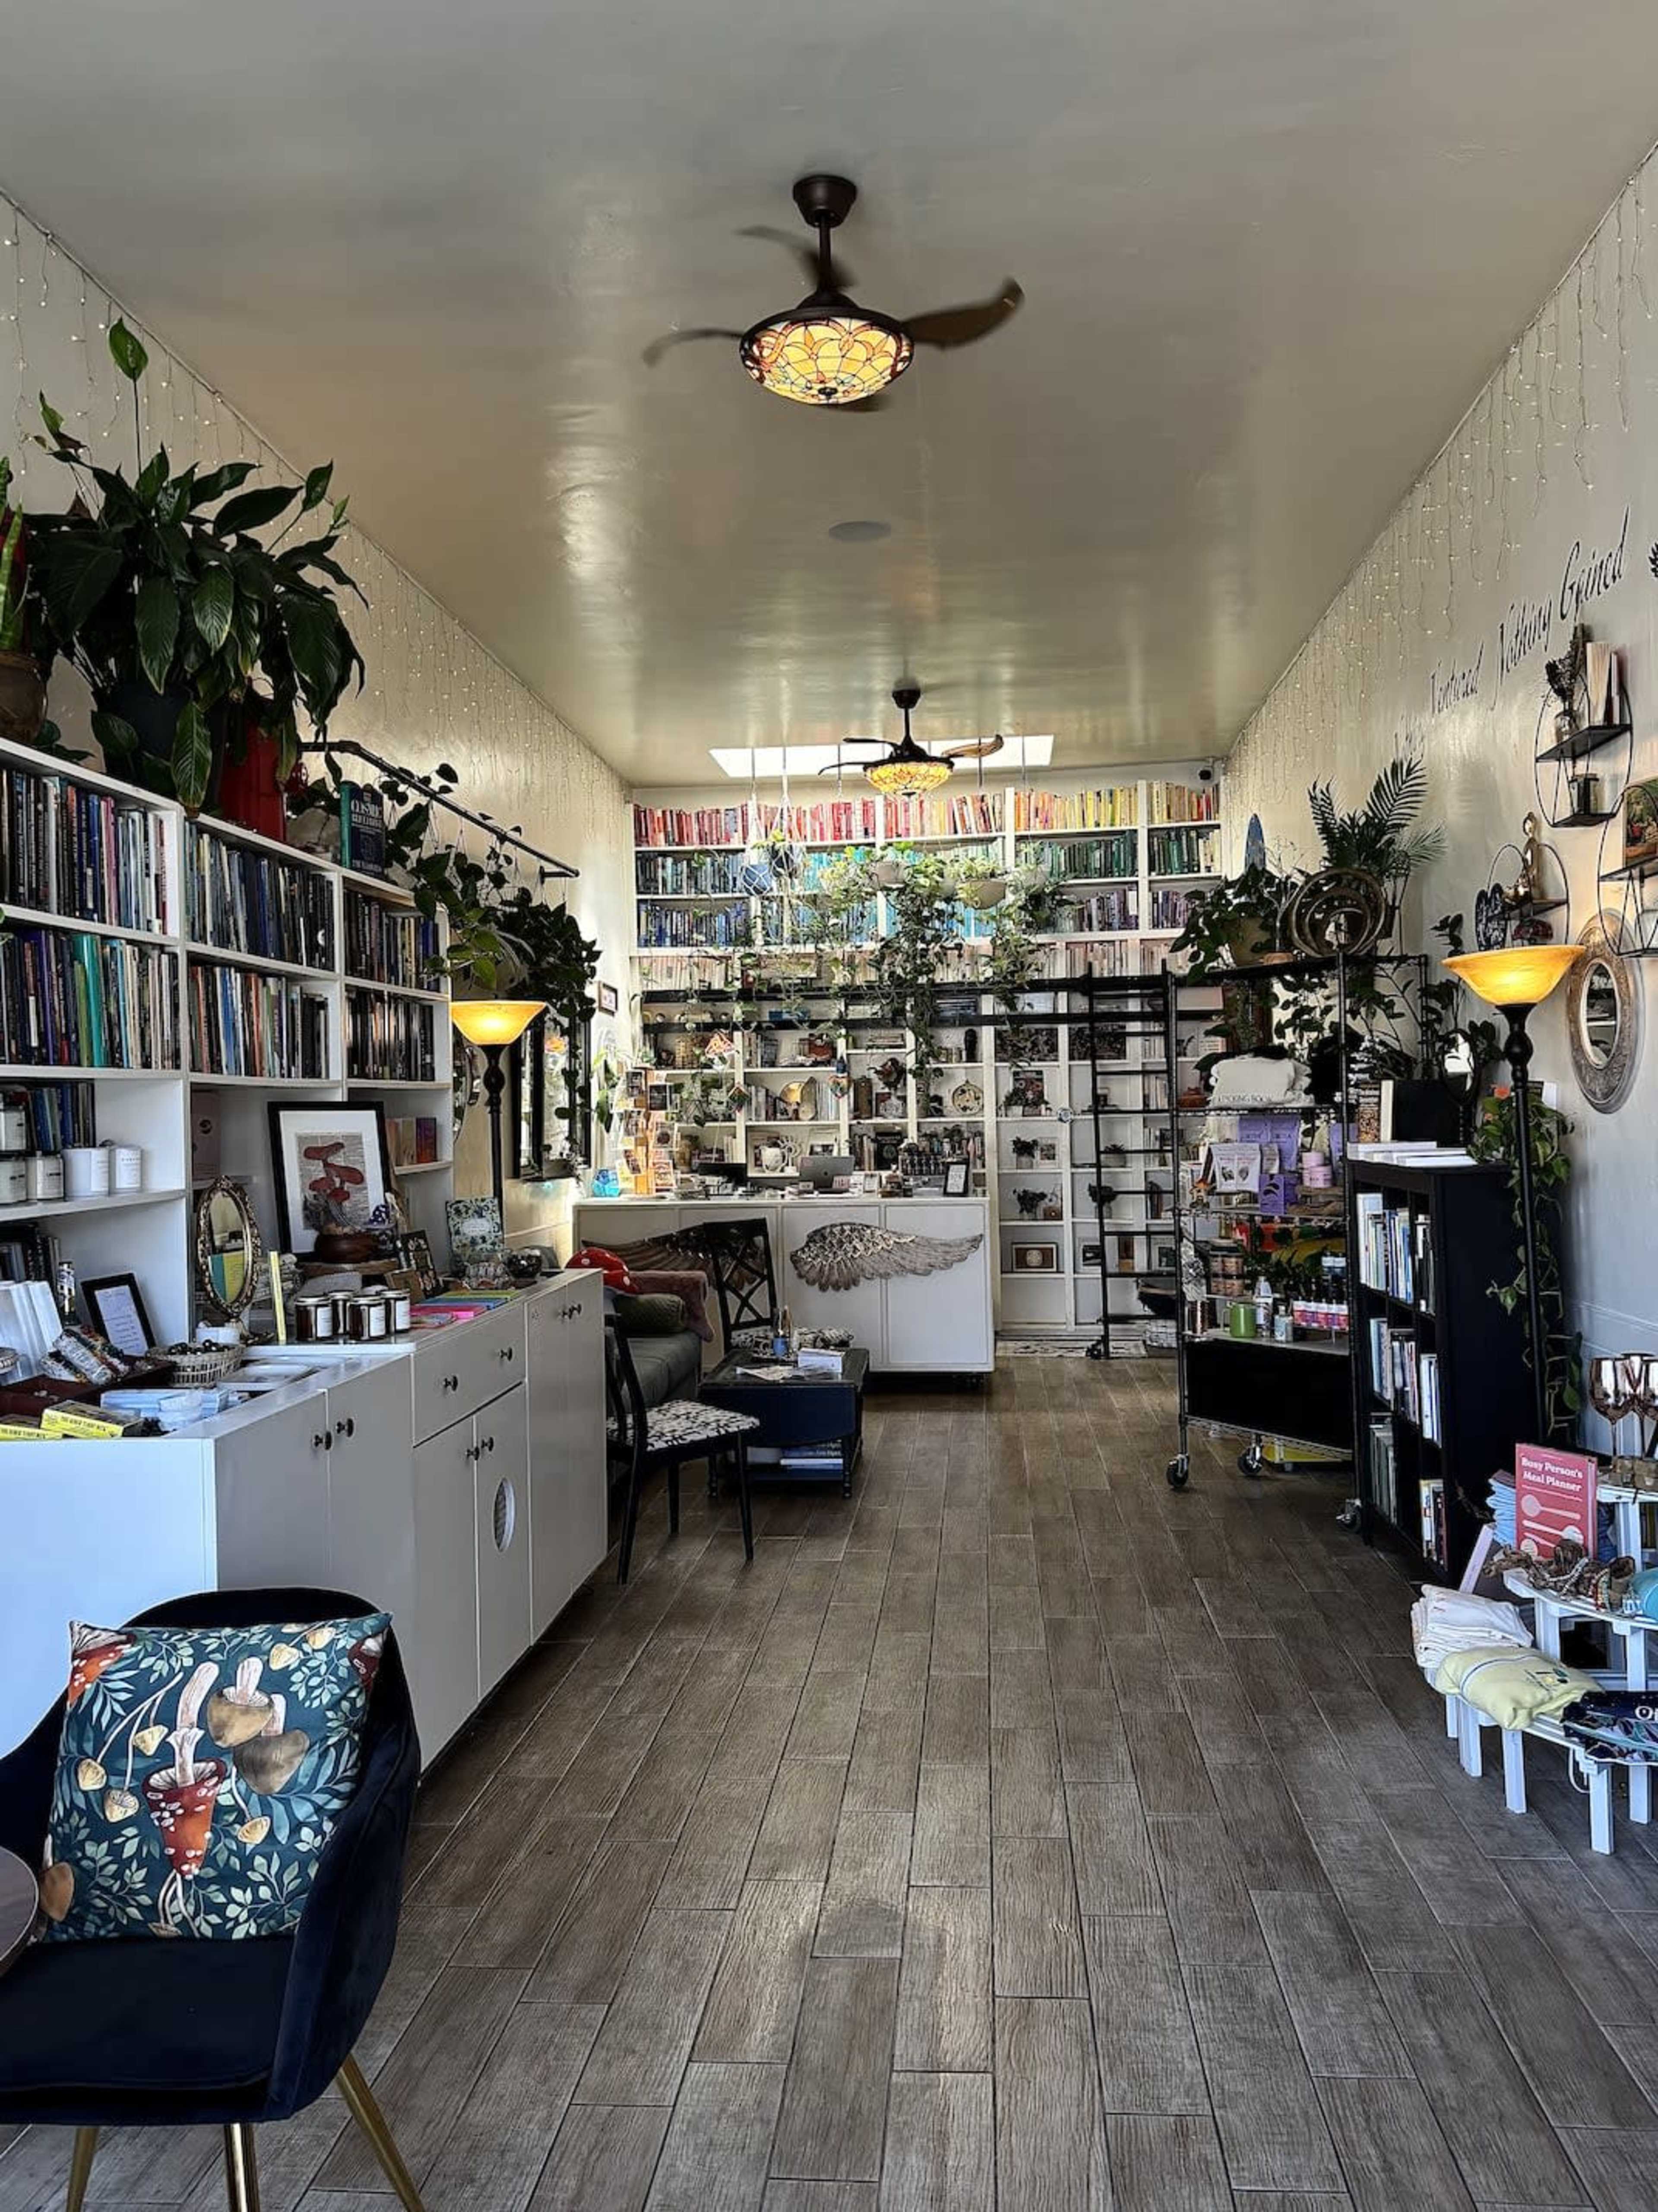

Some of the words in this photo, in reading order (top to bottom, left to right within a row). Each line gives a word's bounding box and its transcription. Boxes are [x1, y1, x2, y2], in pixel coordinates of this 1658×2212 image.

[1521, 1457, 1543, 1471] Busy
[1544, 1462, 1582, 1479] Person's
[1522, 1470, 1545, 1483] Meal
[1546, 1475, 1582, 1492] Planner
